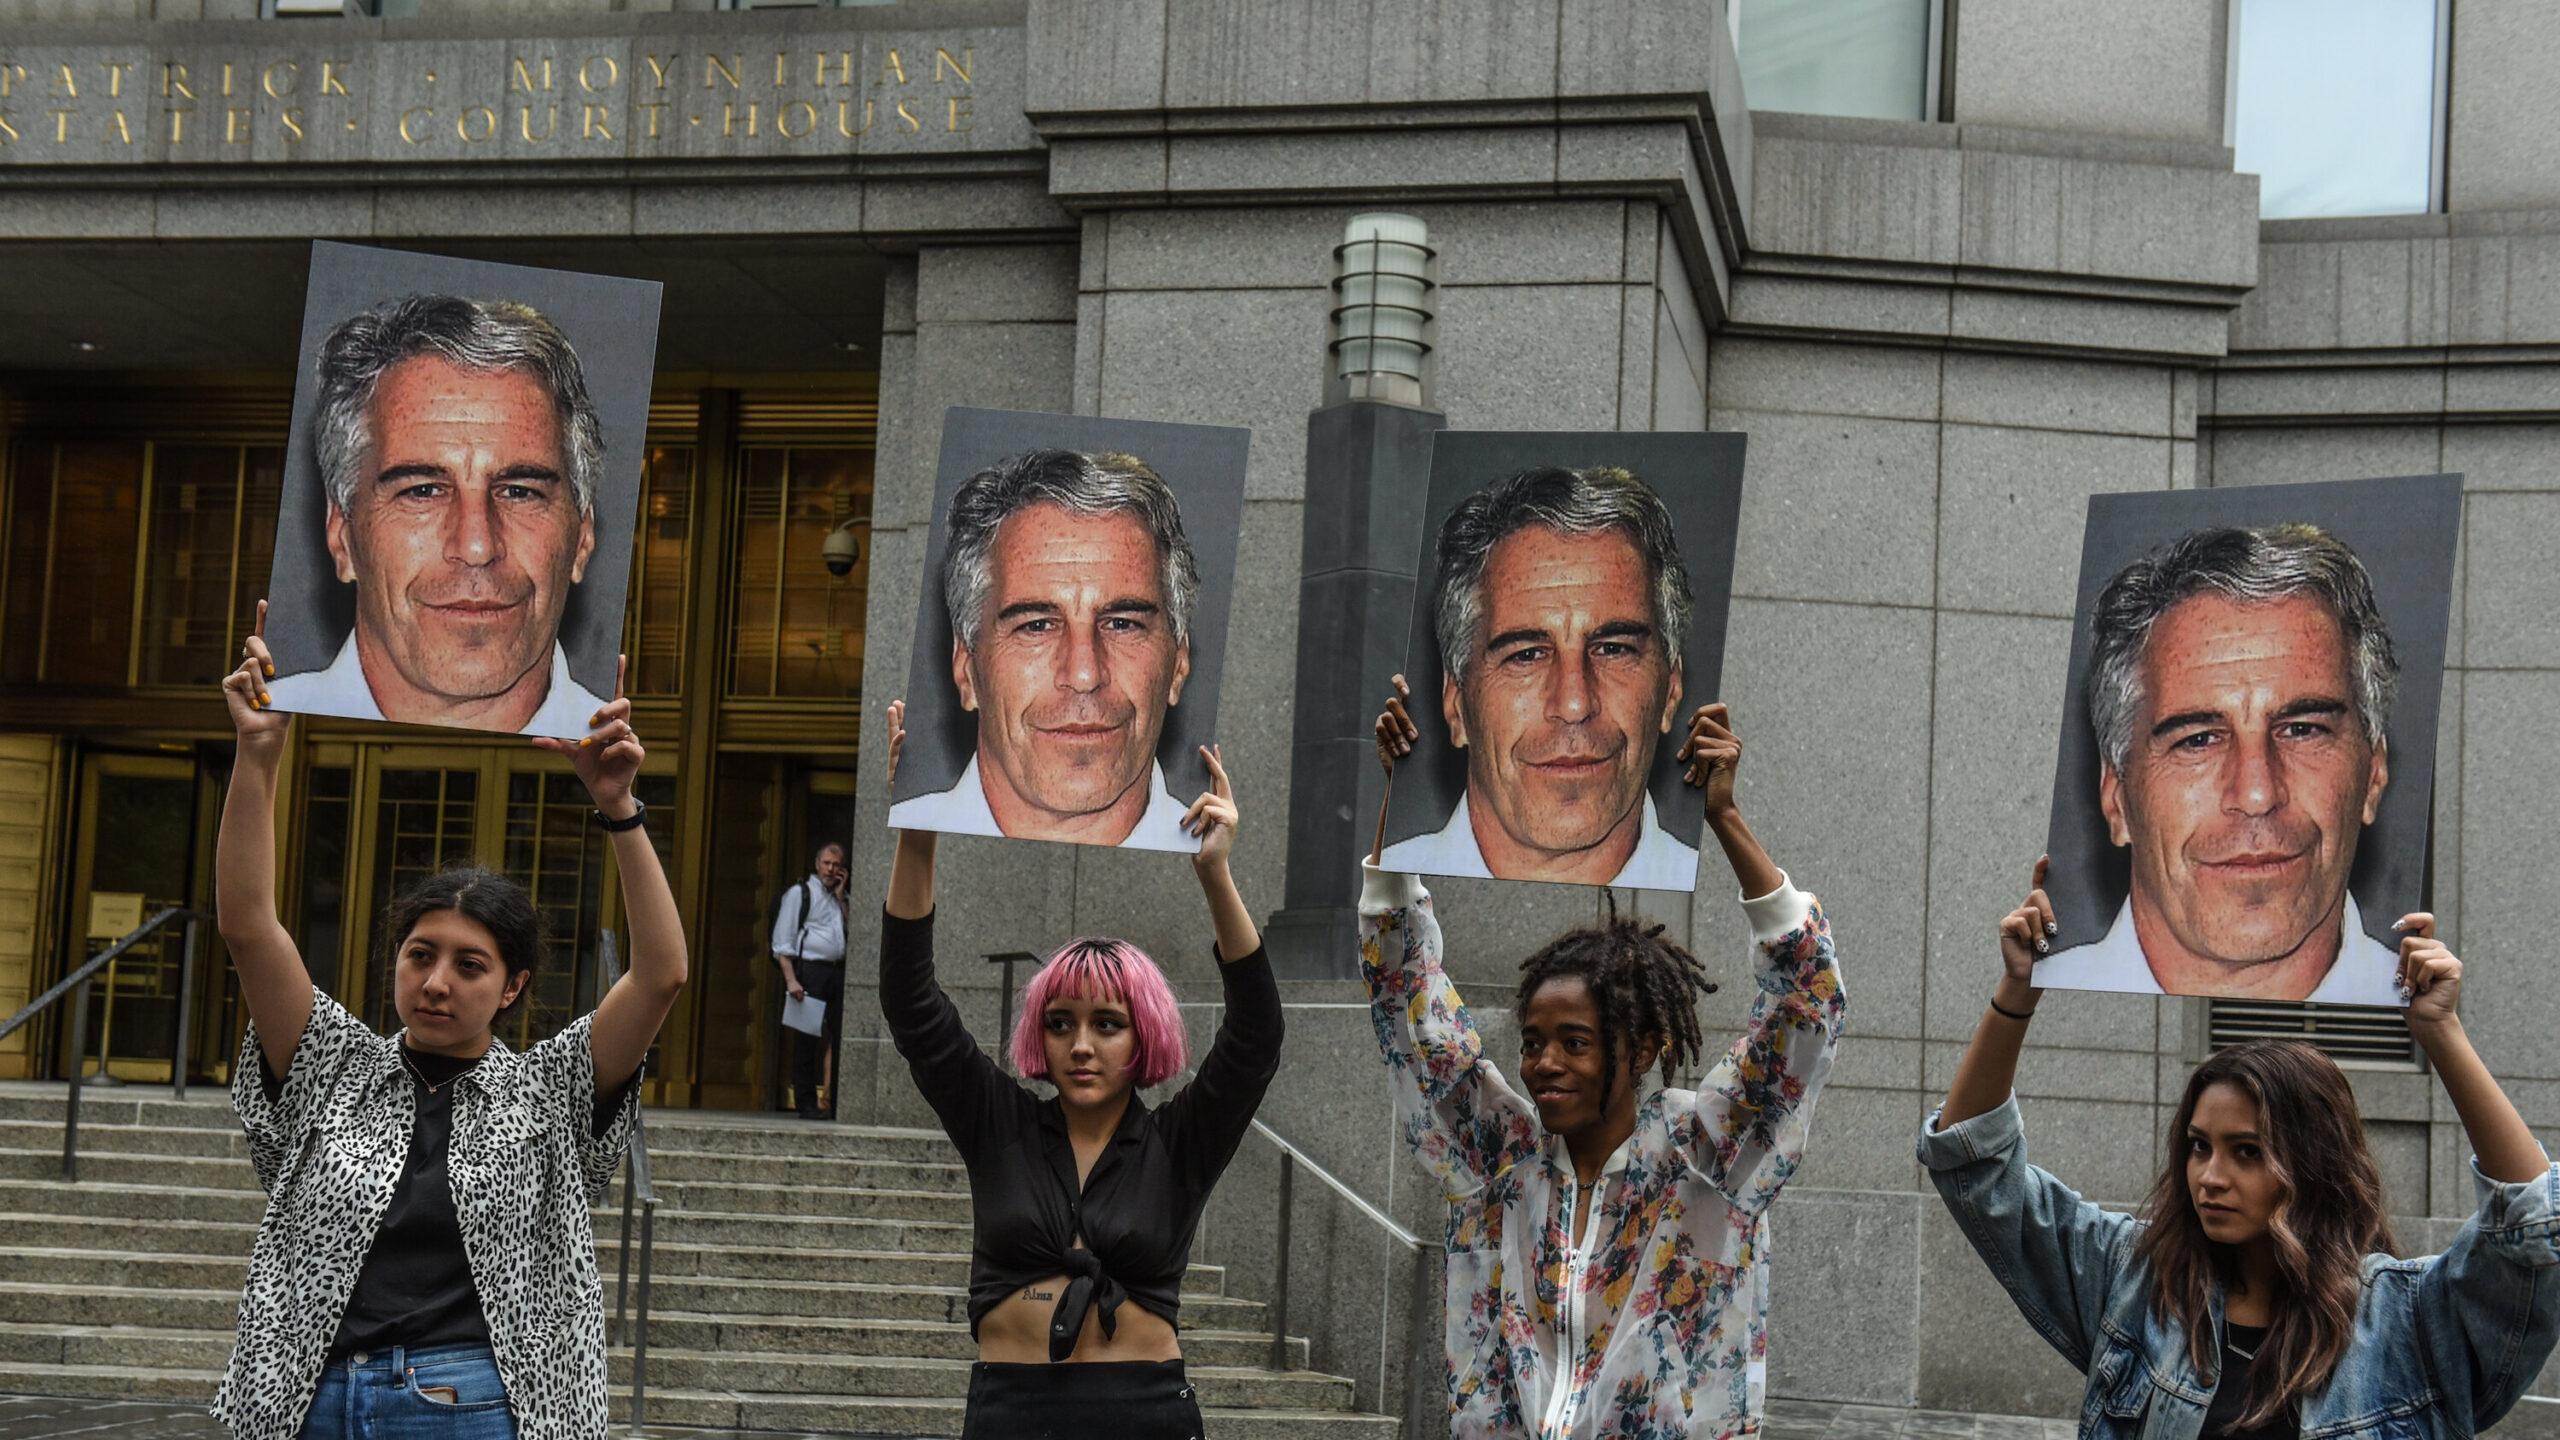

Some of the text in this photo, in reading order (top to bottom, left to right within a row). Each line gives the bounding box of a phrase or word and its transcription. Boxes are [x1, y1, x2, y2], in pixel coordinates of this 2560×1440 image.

[0, 46, 974, 98] PATRICK MOYNIHAN
[0, 106, 303, 145] STATES
